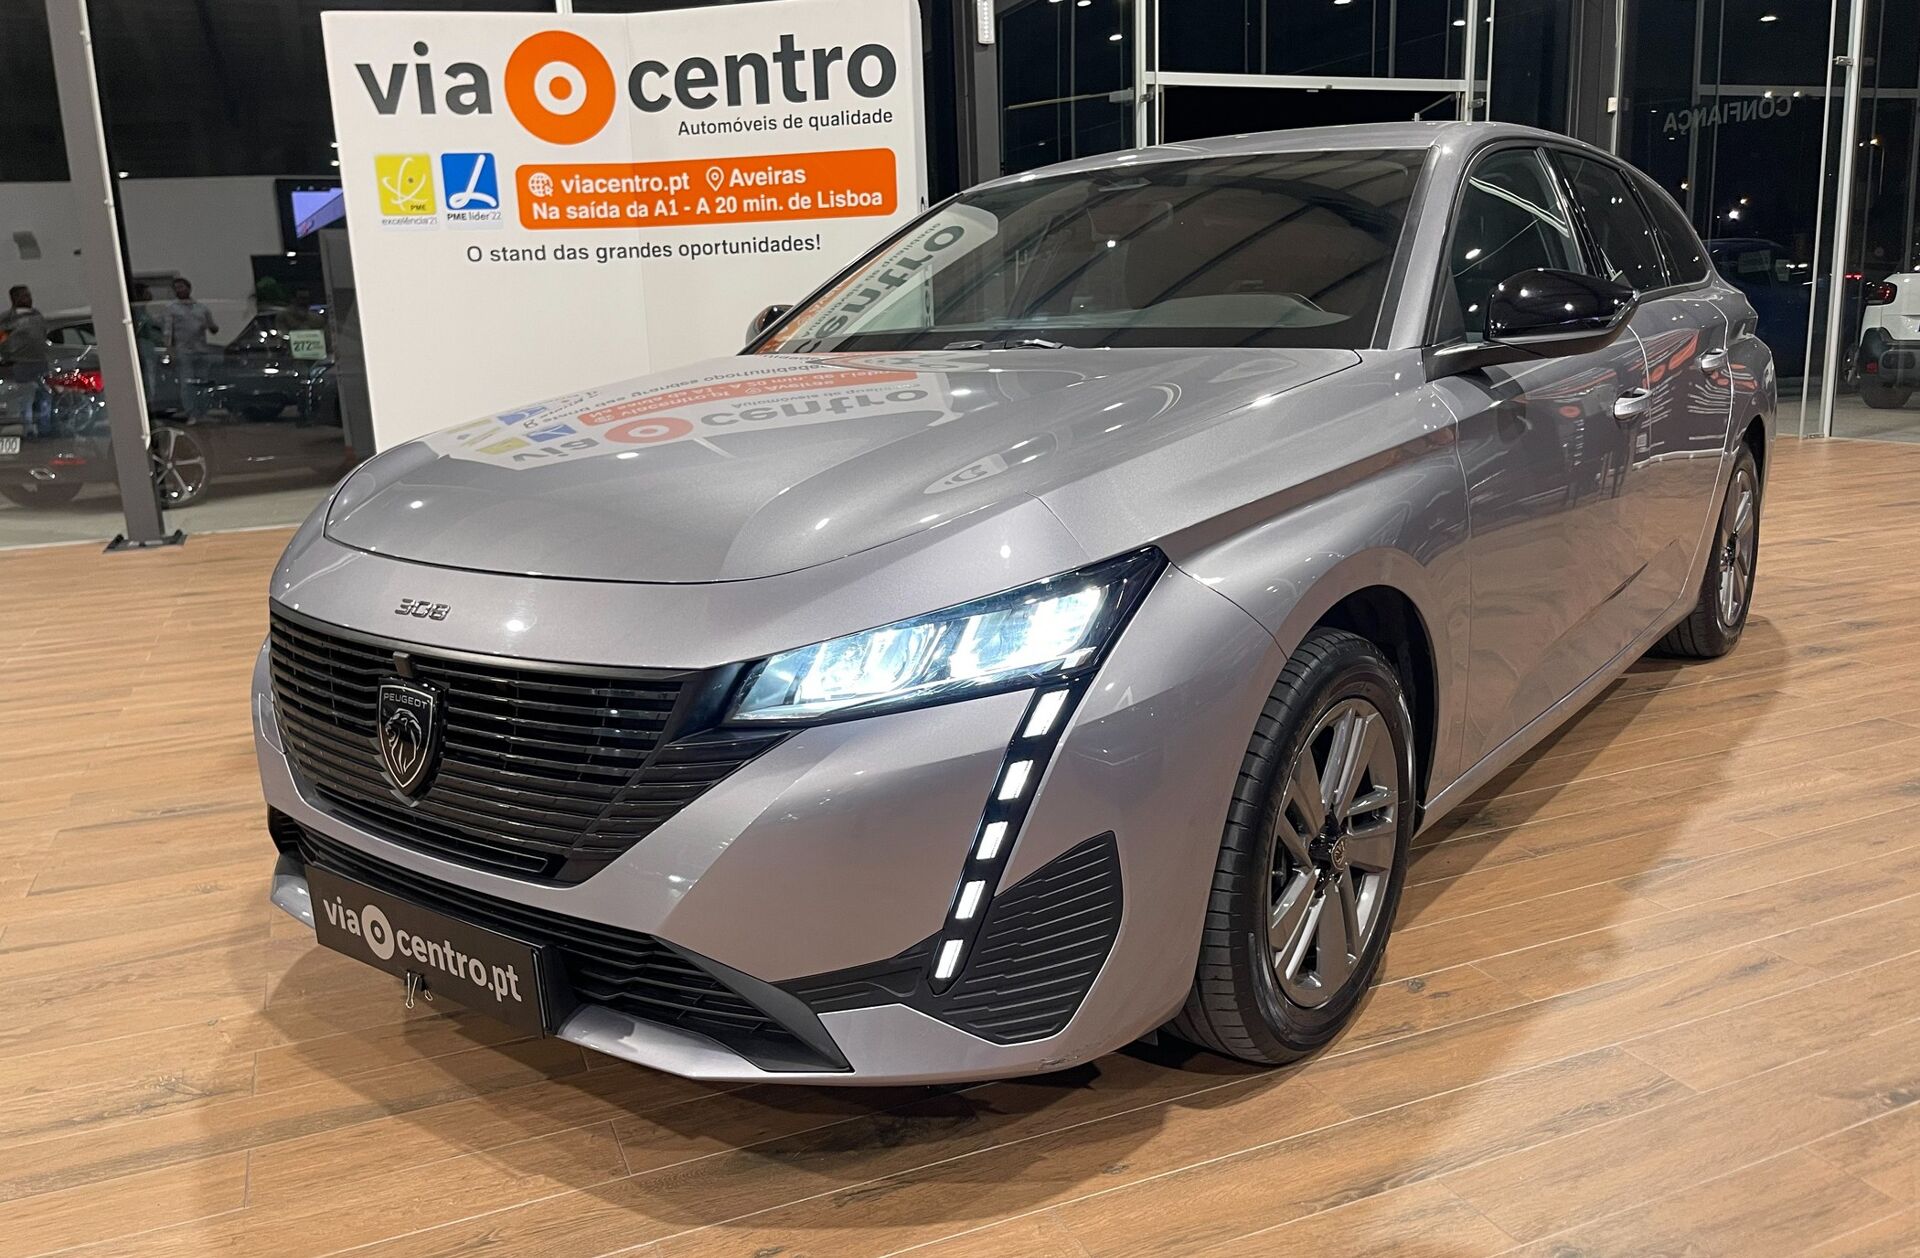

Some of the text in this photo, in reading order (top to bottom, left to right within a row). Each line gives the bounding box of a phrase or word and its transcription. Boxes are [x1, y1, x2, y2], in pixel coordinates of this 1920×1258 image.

[354, 34, 897, 115] via centro
[678, 108, 893, 136] Automóveis de qualidade
[560, 172, 690, 196] viacentro.pt
[729, 166, 807, 188] Aveiras
[447, 212, 467, 222] PME
[532, 202, 561, 220] Na
[566, 201, 620, 219] saída
[626, 200, 649, 218] da
[654, 199, 679, 217] A1
[696, 197, 711, 214] A
[715, 196, 737, 214] 20
[743, 194, 783, 213] min.
[787, 192, 811, 210] de
[817, 190, 882, 209] Lisboa
[467, 233, 821, 264] O stand das grandes oportunidades!
[394, 598, 452, 621] 308
[383, 692, 429, 710] PEUGEOT
[396, 929, 522, 1003] centro.pt
